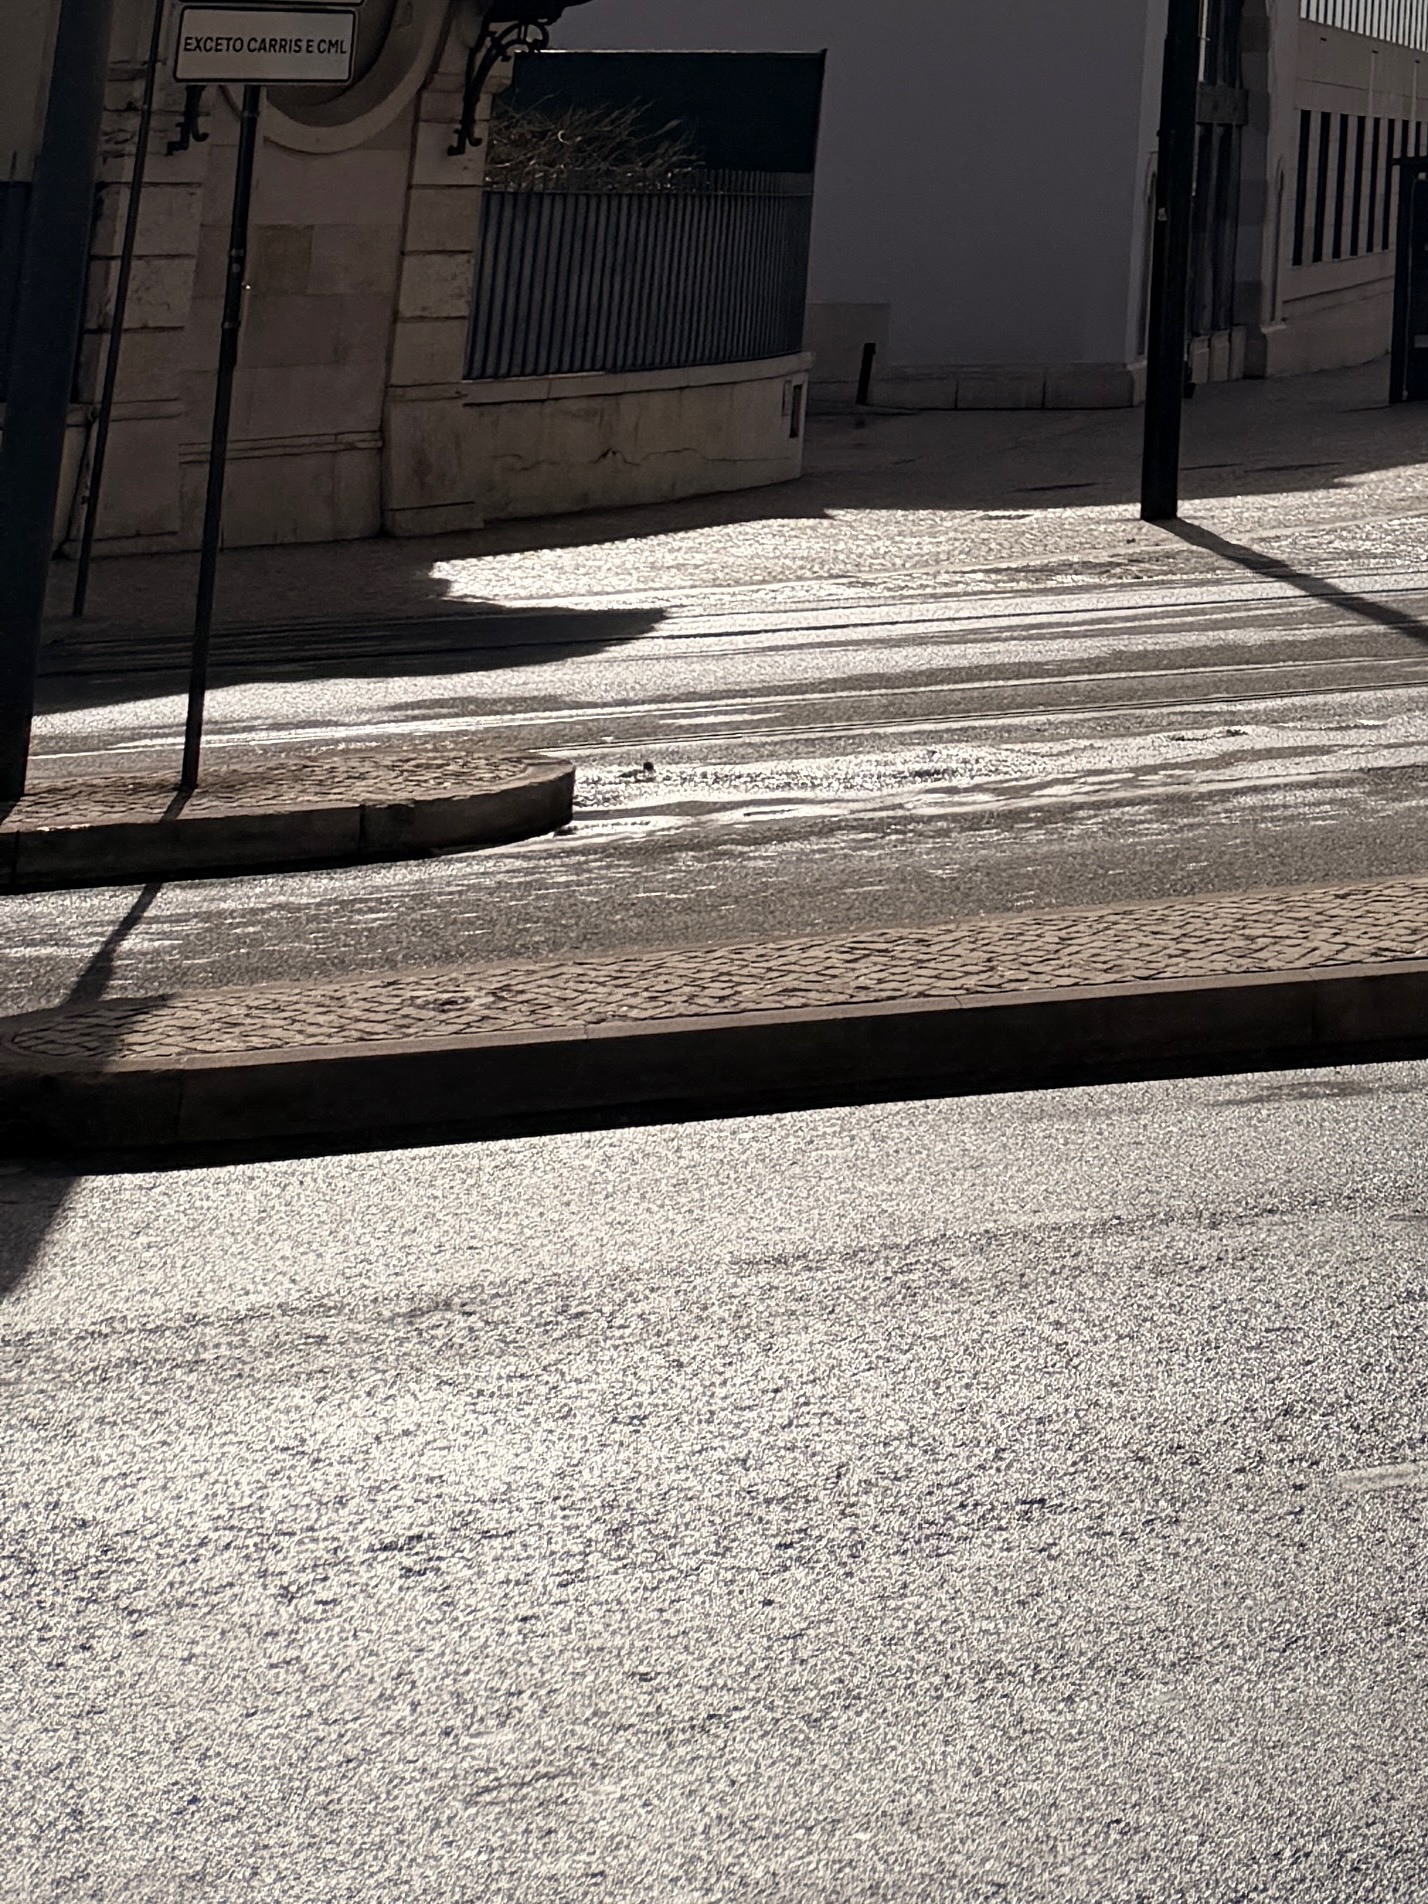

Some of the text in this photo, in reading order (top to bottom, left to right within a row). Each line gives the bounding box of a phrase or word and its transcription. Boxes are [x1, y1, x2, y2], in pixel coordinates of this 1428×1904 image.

[183, 36, 348, 55] EXCETO CARRIS E CML
